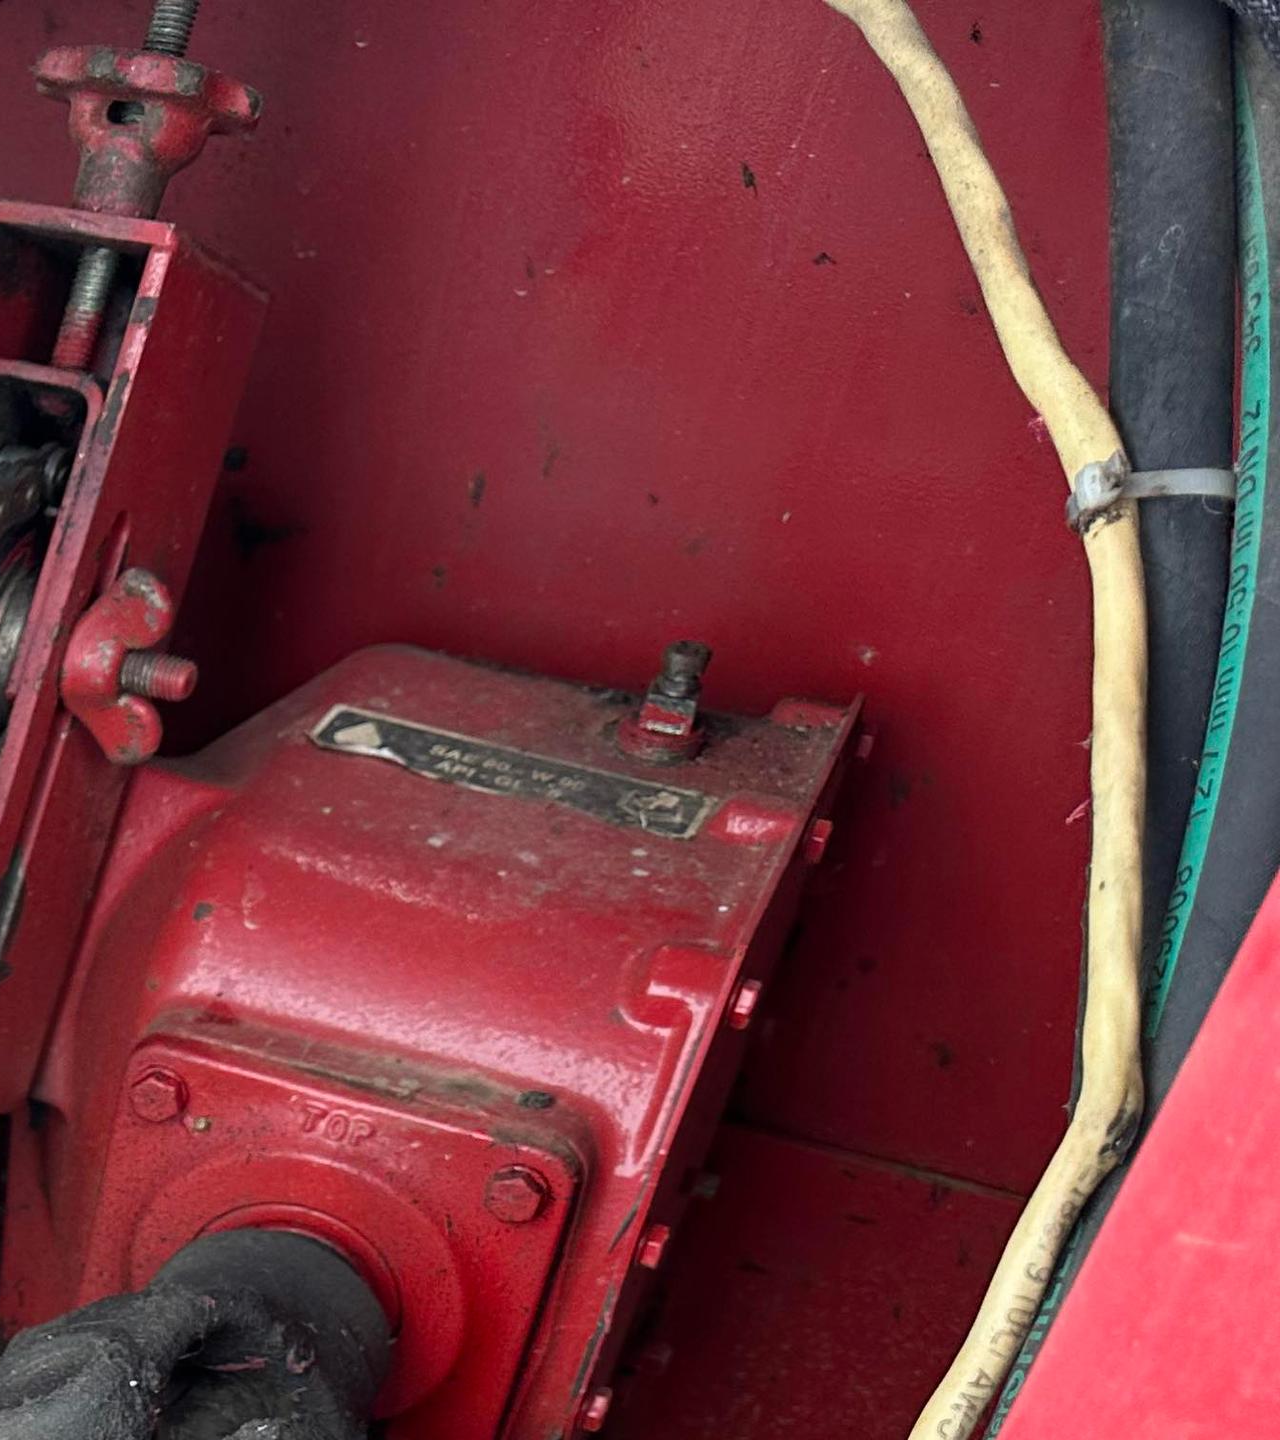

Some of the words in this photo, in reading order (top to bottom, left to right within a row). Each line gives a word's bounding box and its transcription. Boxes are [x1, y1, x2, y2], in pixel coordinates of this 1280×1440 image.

[1190, 750, 1219, 820] 12.7
[1210, 666, 1236, 732] mm
[1237, 399, 1261, 505] DN12
[303, 1100, 376, 1146] TOP
